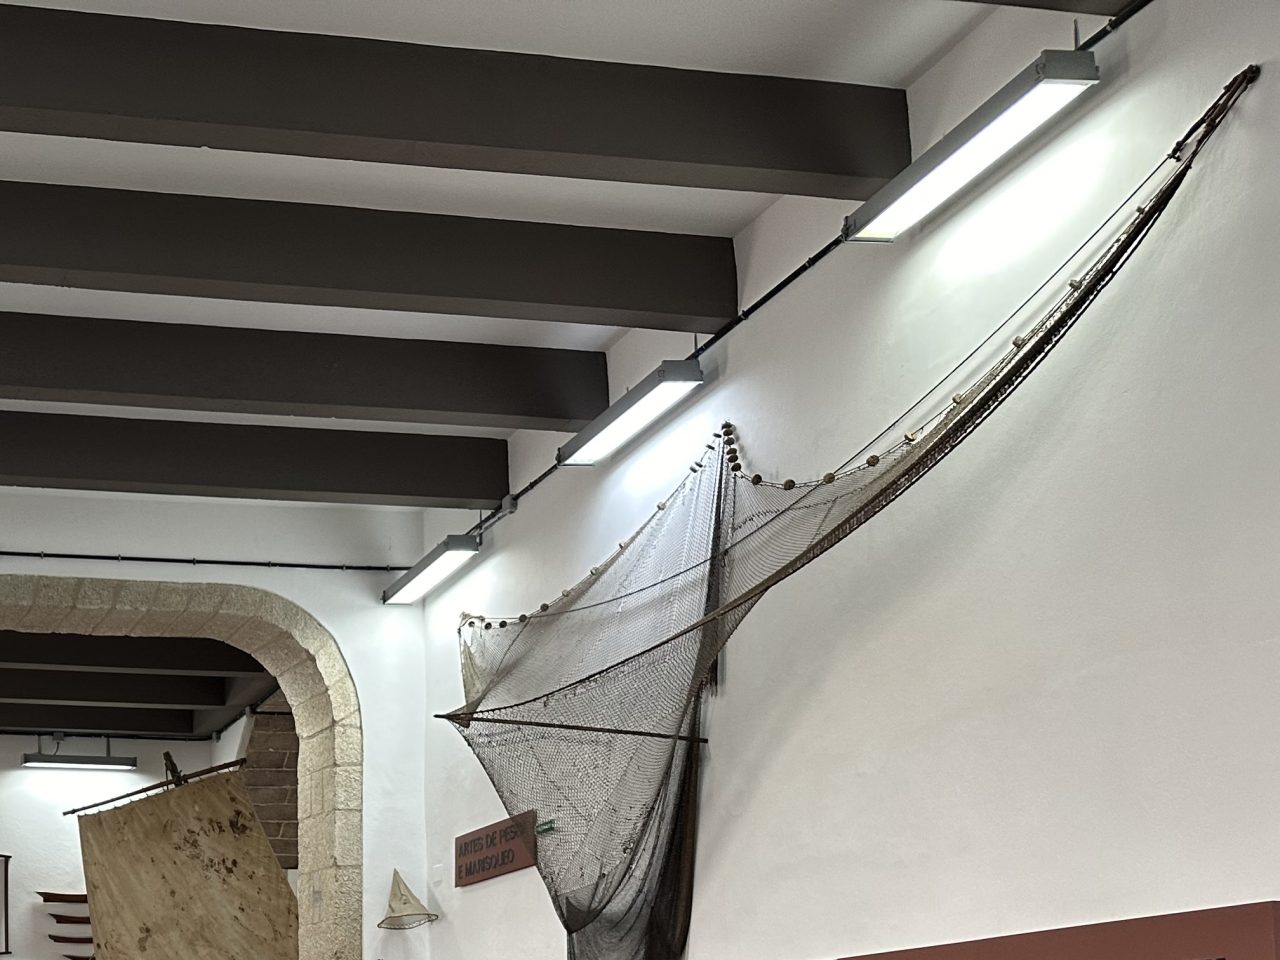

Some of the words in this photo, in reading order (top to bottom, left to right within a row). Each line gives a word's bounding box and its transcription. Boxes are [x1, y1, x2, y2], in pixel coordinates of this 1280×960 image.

[459, 837, 484, 858] ARTES
[486, 831, 497, 849] DE
[458, 864, 463, 880] E
[465, 849, 515, 877] MARISQUEO
